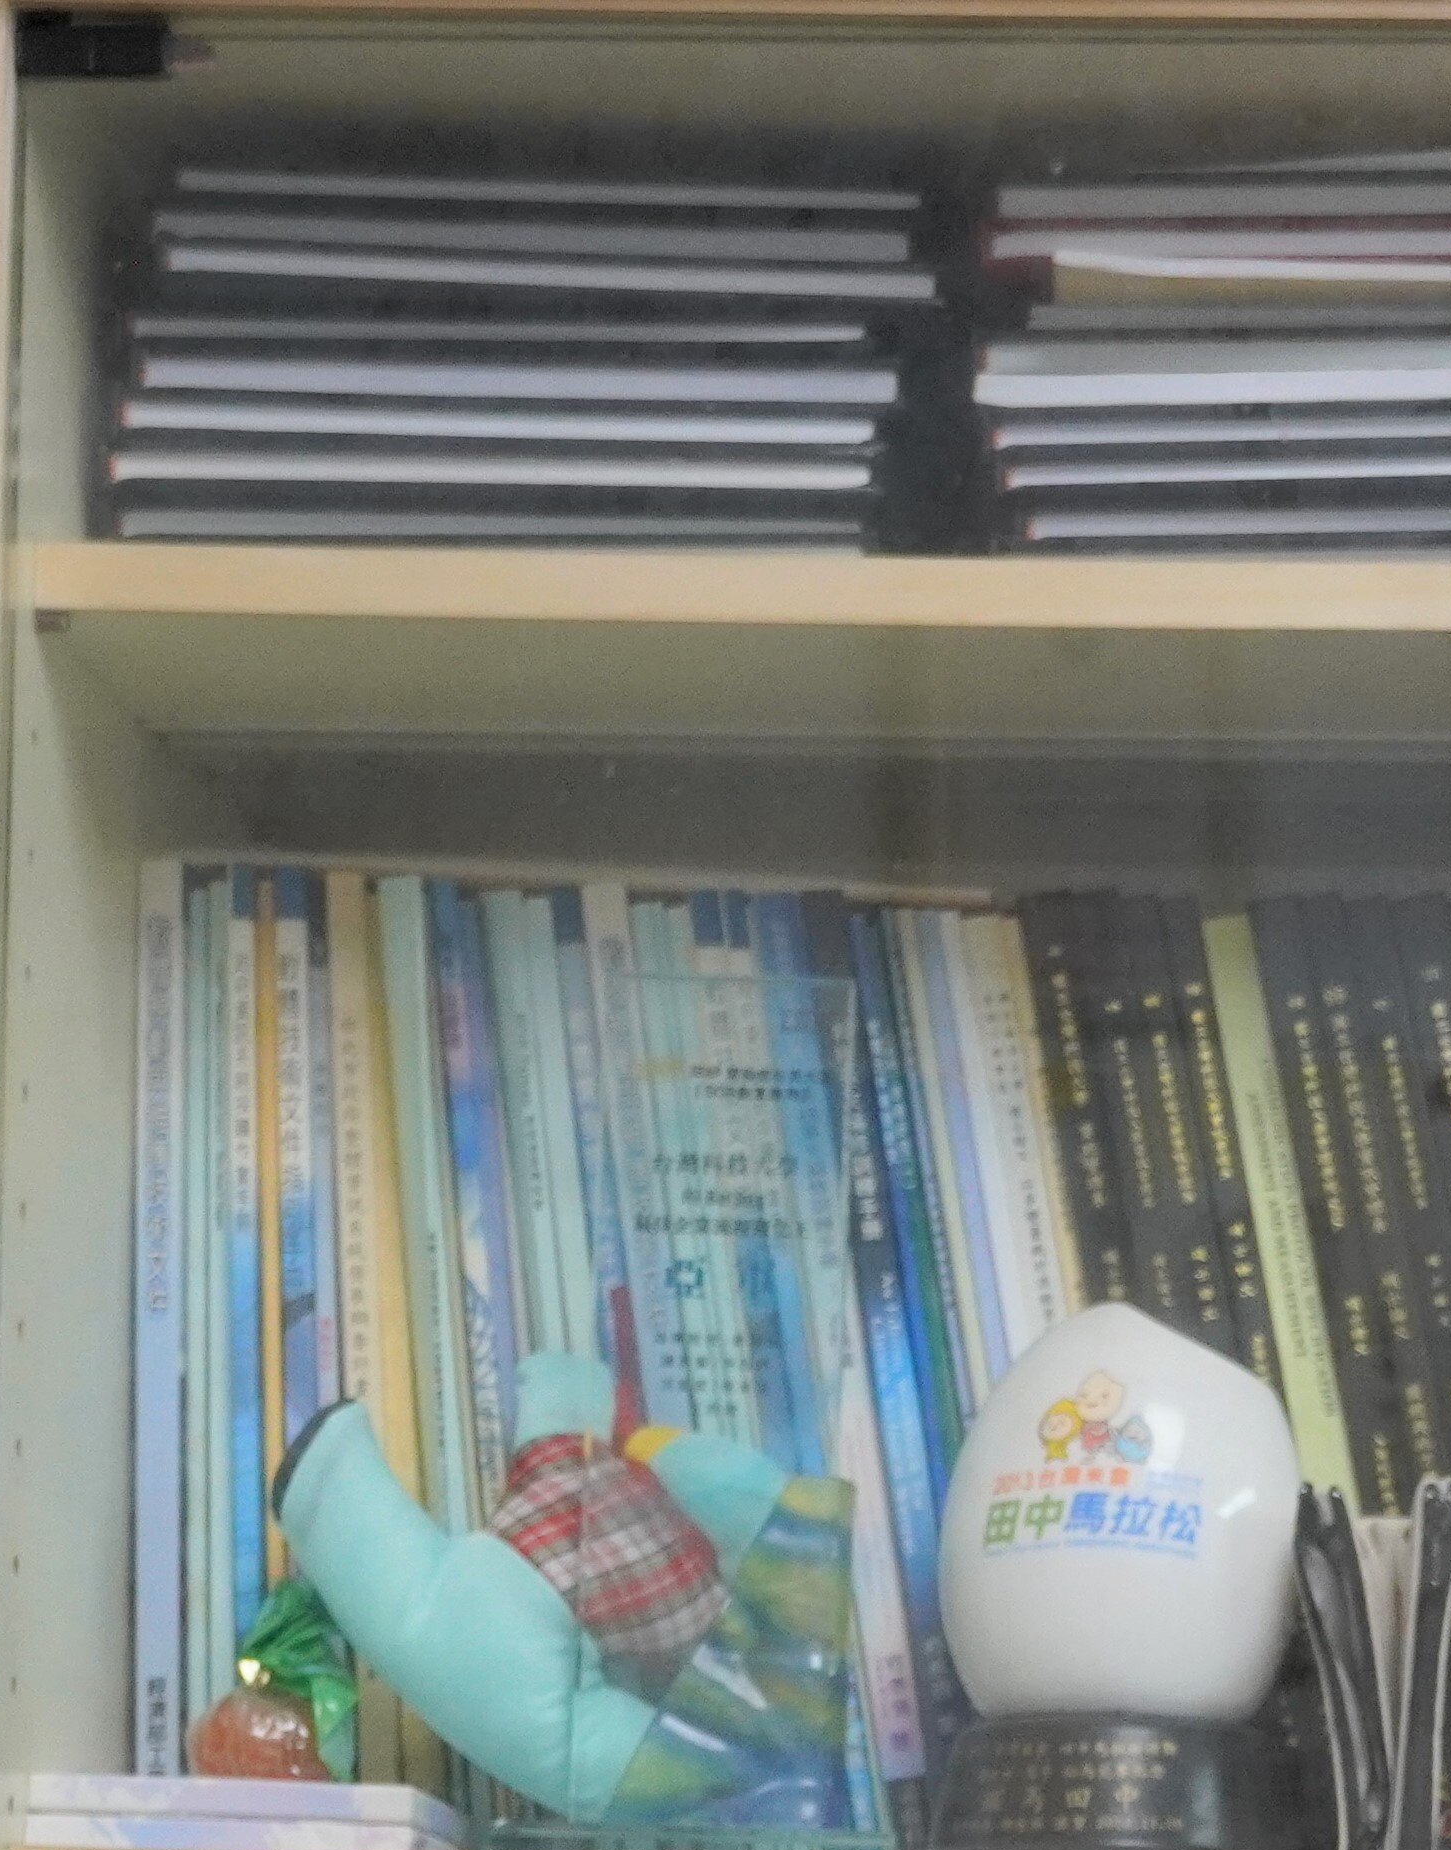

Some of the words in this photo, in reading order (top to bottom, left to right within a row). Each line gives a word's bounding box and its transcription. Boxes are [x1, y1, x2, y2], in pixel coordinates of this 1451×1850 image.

[983, 1491, 1203, 1548] 田中馬拉松
